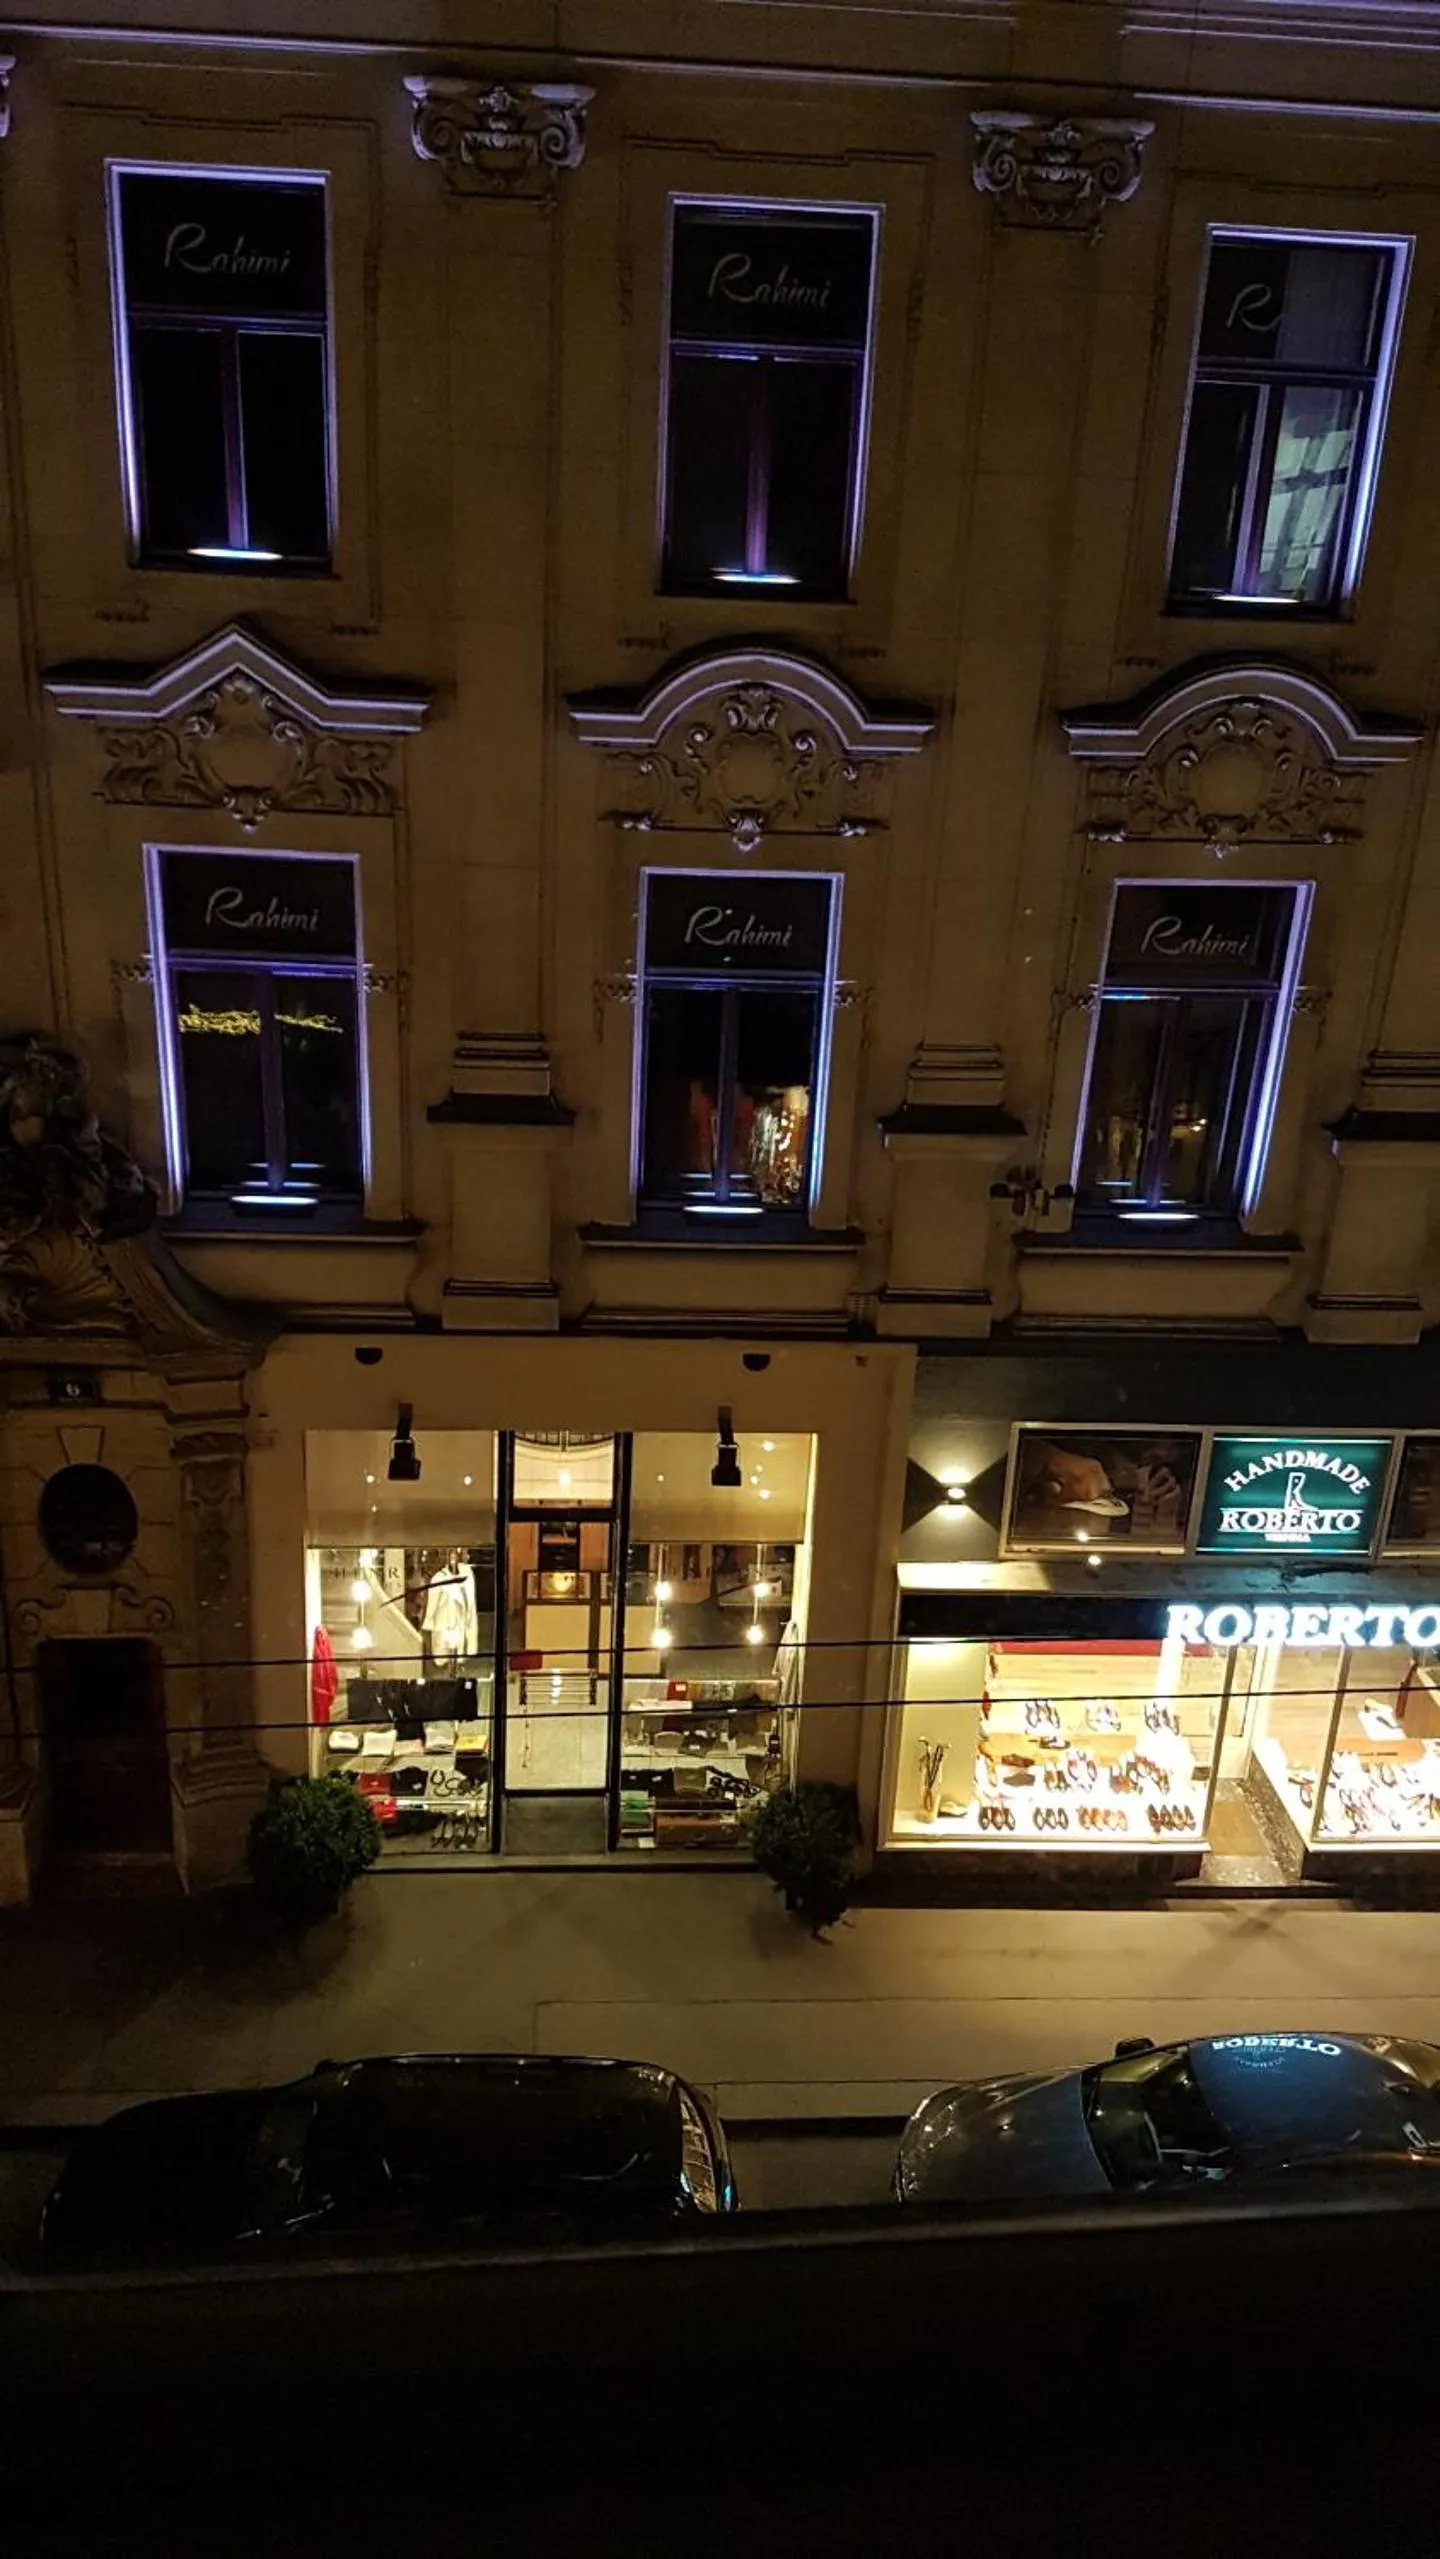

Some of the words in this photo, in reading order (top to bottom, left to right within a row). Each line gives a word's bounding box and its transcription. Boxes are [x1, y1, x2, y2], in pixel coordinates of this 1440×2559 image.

[164, 222, 291, 274] Rahimi
[708, 253, 832, 307] Rahimi
[205, 886, 320, 931] Rahimi
[684, 906, 793, 947] Rahimi
[1141, 916, 1250, 957] Rahimi
[1224, 1450, 1372, 1495] HANDMADE
[1221, 1510, 1361, 1531] ROBERTO
[1166, 1604, 1440, 1647] ROBERTO
